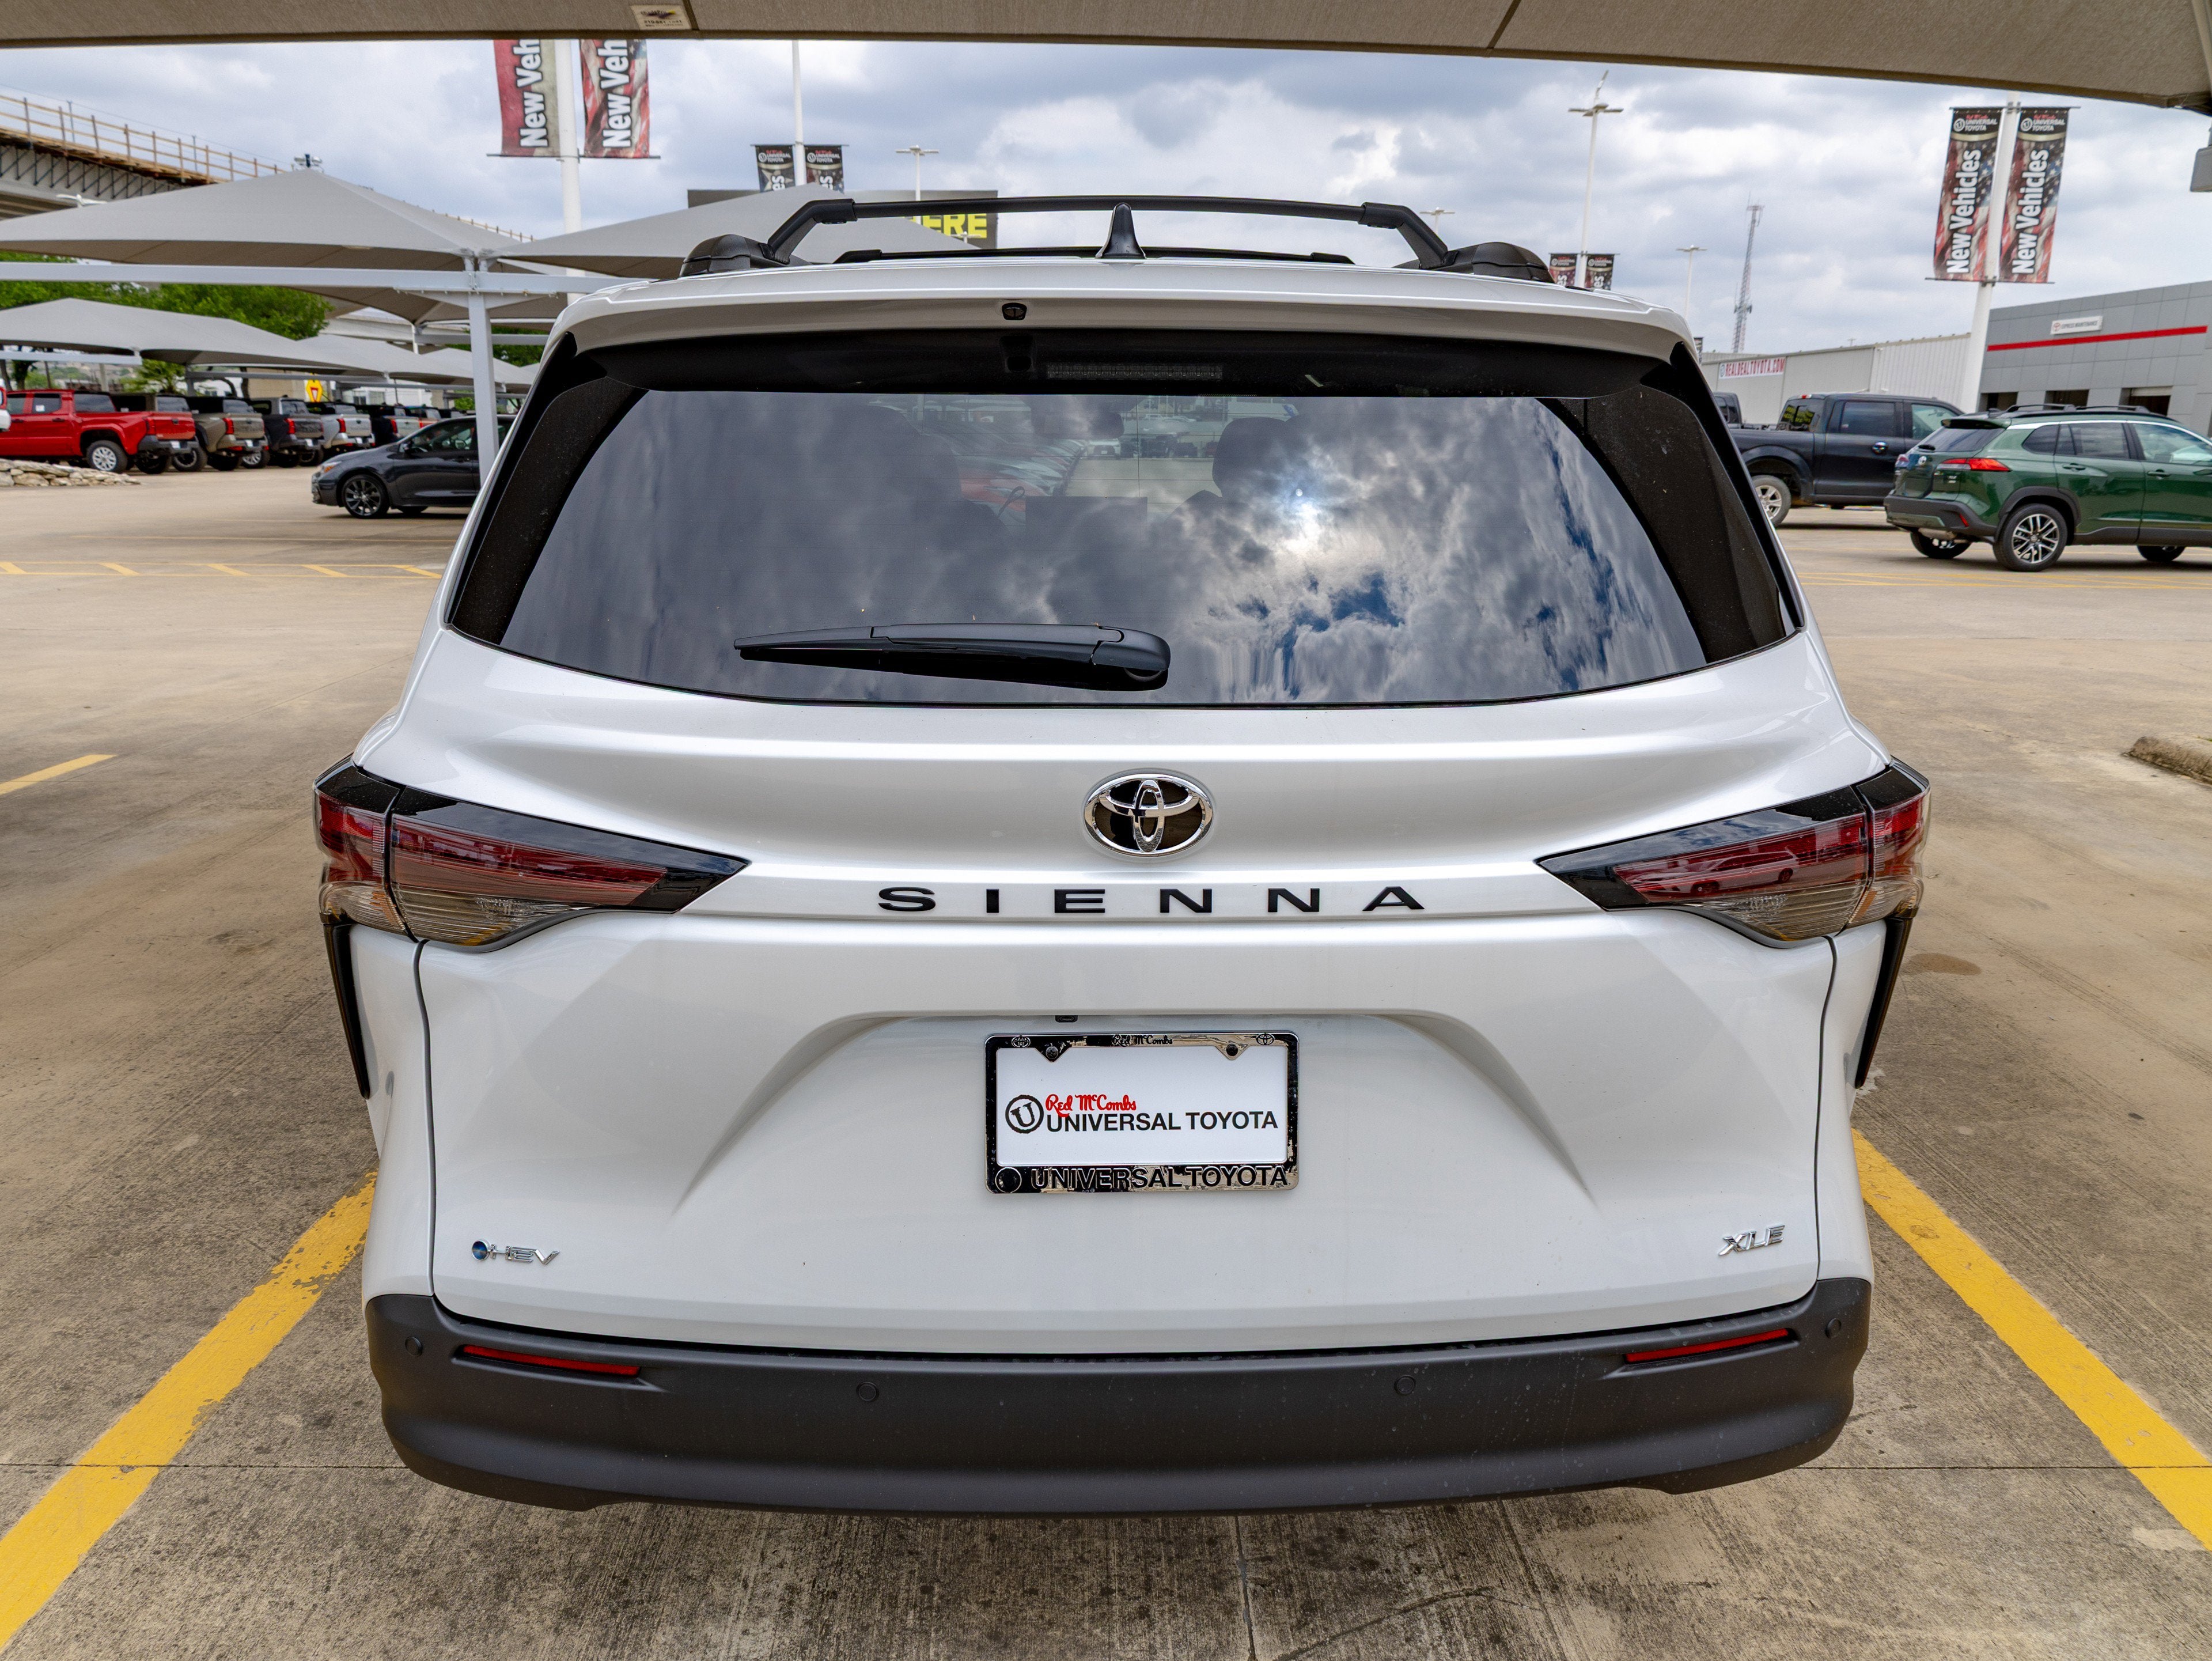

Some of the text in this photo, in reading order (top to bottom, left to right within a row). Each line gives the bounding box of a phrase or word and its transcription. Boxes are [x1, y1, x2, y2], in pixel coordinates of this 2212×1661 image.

[520, 92, 548, 147] New
[603, 93, 631, 147] New
[1949, 149, 1982, 230] Vehicles
[2016, 150, 2049, 230] Vehicles
[904, 213, 987, 239] ERE
[1946, 233, 1972, 274] New
[2012, 233, 2037, 274] New
[878, 886, 1425, 913] SIENNA
[1112, 1034, 1131, 1047] Red
[1046, 1094, 1137, 1117] Red McCombs
[1047, 1111, 1278, 1132] UNIVERSAL TOYOTA
[1031, 1166, 1288, 1189] UNIVERSAL TOYOTA
[490, 1244, 560, 1266] HEV
[1718, 1225, 1785, 1256] XLE
